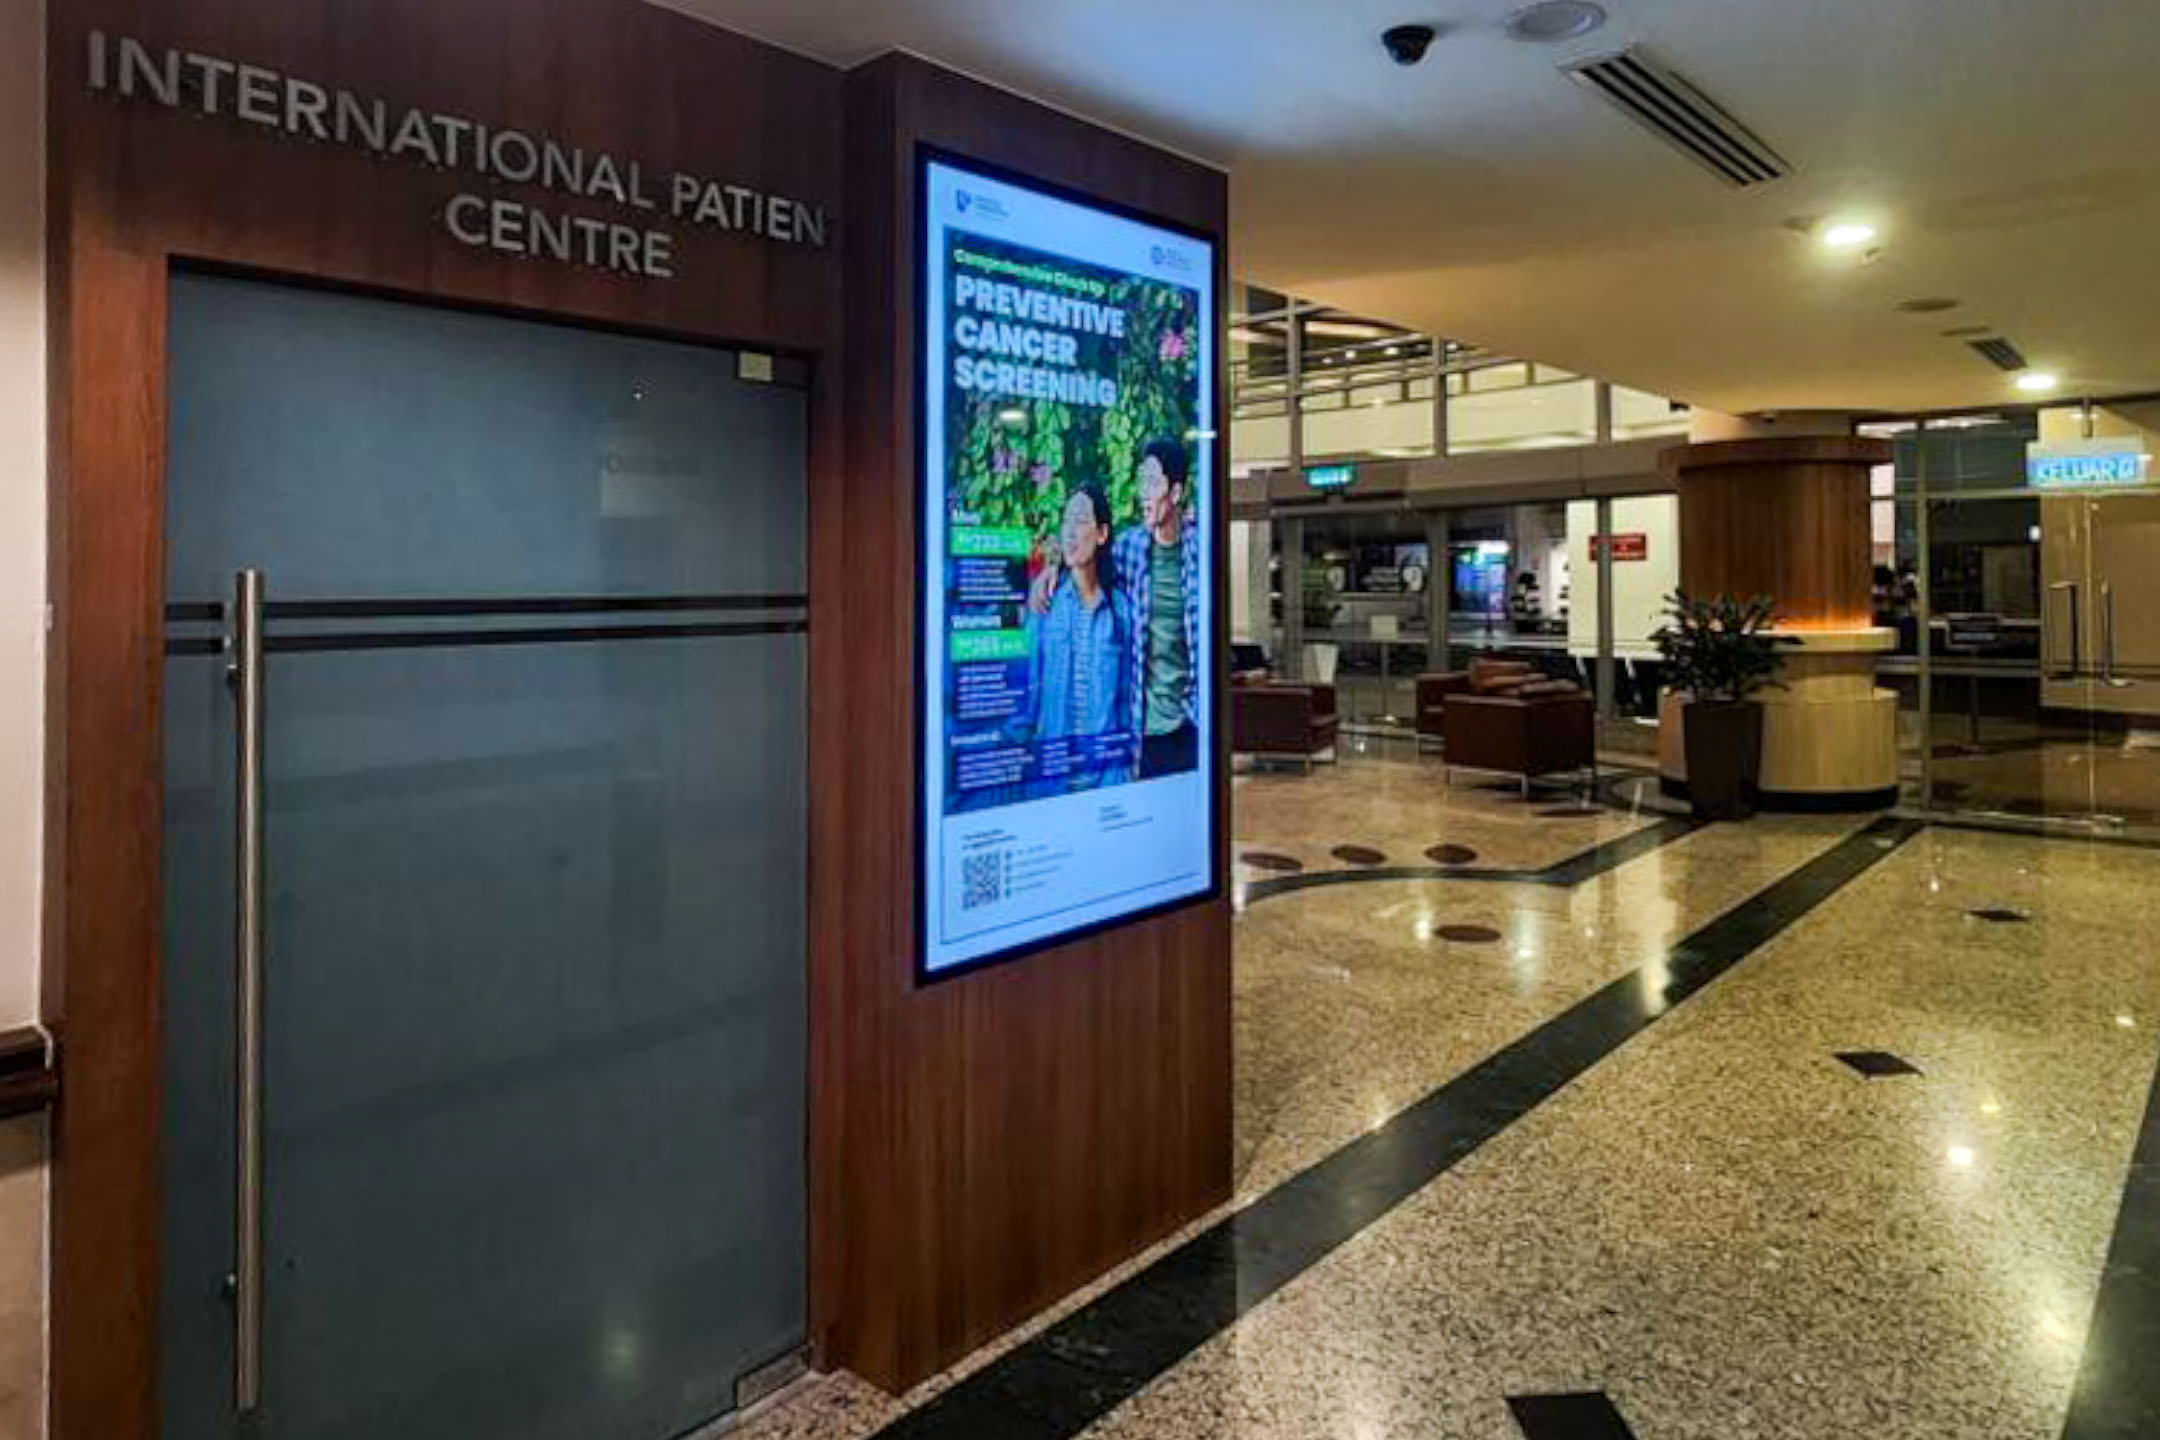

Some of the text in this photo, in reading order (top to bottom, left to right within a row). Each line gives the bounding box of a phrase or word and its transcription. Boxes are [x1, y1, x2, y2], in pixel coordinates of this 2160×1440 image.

[89, 30, 654, 207] INTERNATIONAL
[444, 194, 675, 278] CENTRE
[956, 275, 1125, 338] PREVENTIVE
[955, 317, 1077, 366] CANCER
[954, 356, 1117, 407] SCREENING
